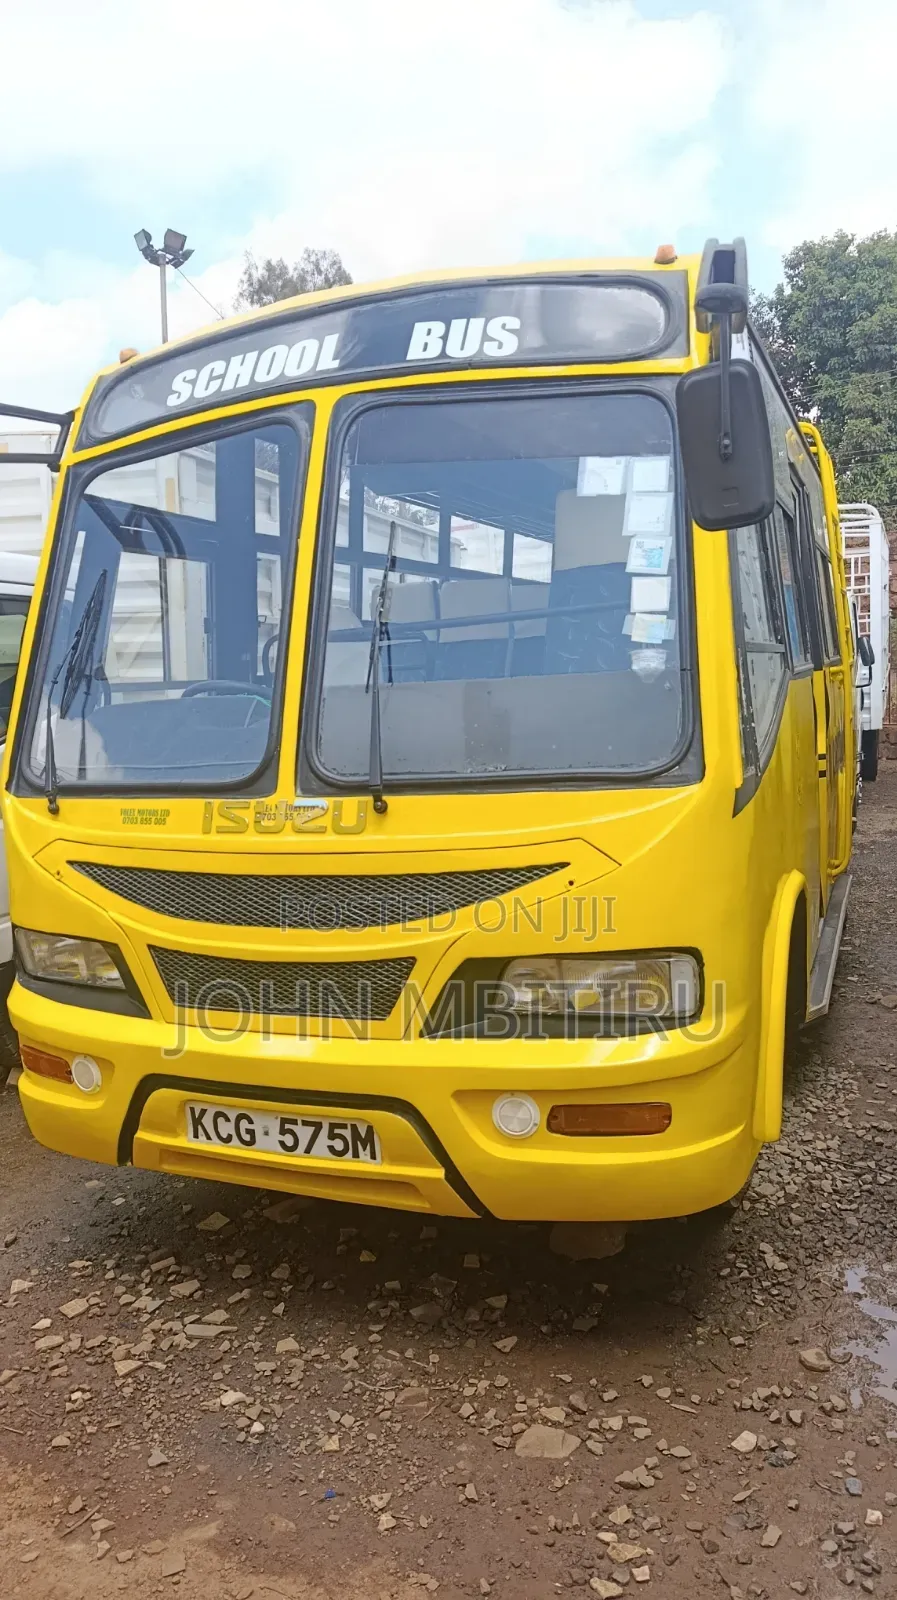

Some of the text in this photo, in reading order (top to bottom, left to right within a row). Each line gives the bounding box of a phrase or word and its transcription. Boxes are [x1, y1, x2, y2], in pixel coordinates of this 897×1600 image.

[166, 315, 521, 407] SCHOOL BUS
[122, 816, 138, 825] 0703
[153, 817, 167, 826] 005
[137, 808, 159, 818] MOTORS
[160, 808, 170, 818] LTD
[201, 800, 368, 835] ISUZU
[188, 1106, 377, 1161] KCG 575M
